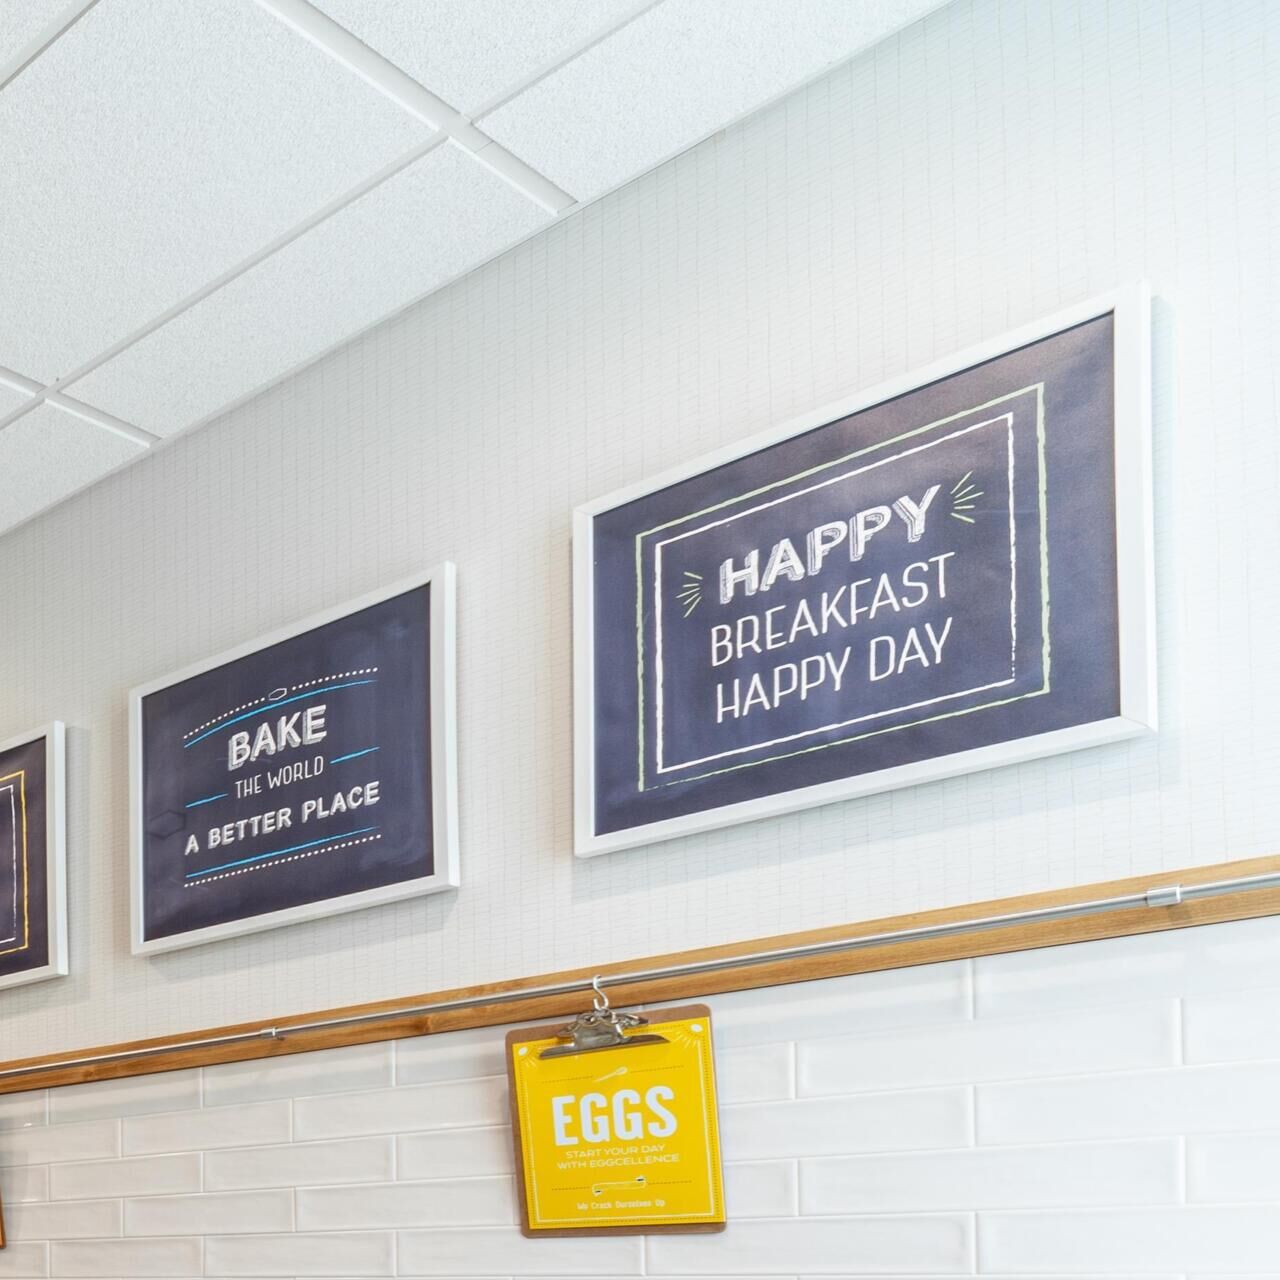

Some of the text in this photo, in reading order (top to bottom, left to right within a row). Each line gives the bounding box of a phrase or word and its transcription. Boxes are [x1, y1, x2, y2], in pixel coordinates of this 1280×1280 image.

[719, 484, 941, 605] HAPPY
[711, 551, 956, 667] BREAKFAST
[716, 617, 953, 724] HAPPY DAY
[228, 704, 328, 770] BAKE
[235, 756, 325, 799] THE WORLD
[184, 781, 381, 856] A BETTER PLACE
[551, 1085, 678, 1147] EGGS
[556, 1153, 680, 1170] WITH EGGCELLENCE
[566, 1144, 665, 1159] START YOUR DAY
